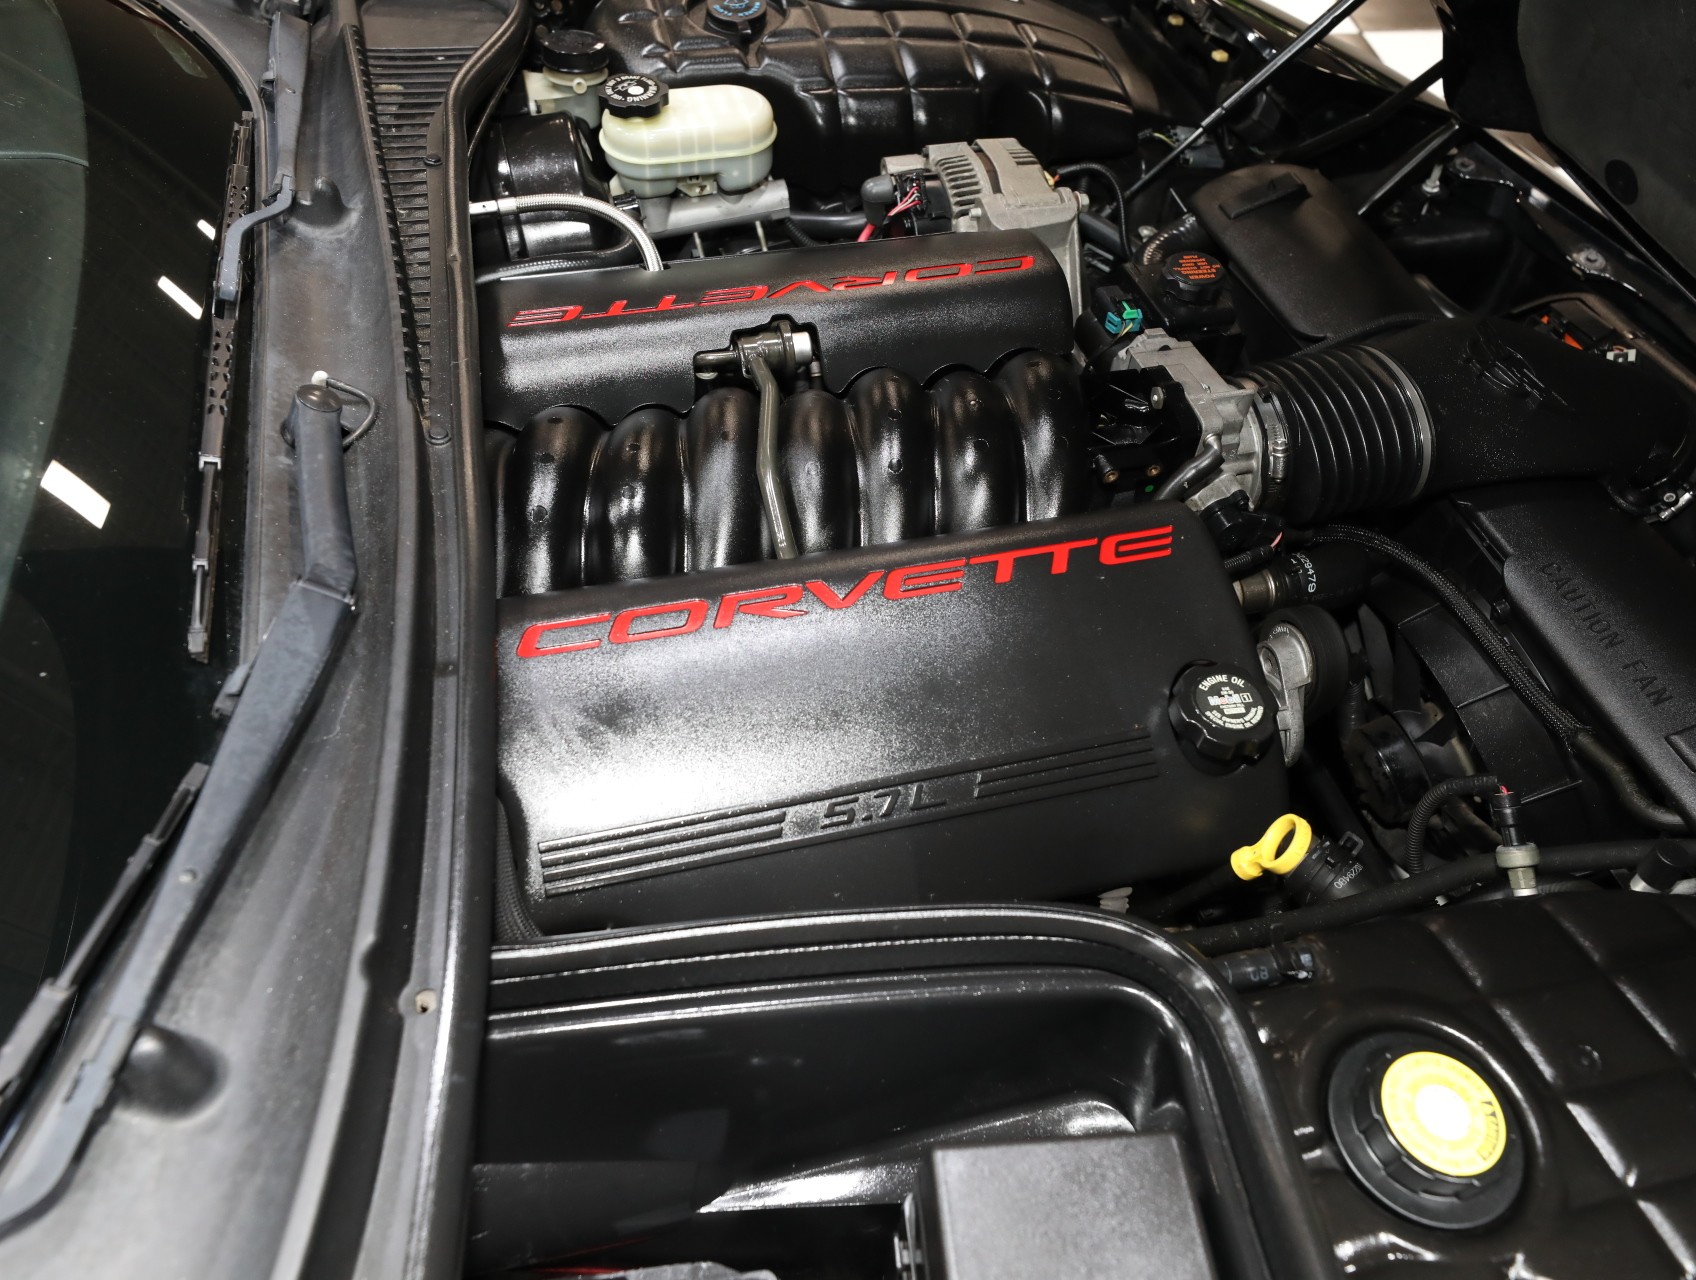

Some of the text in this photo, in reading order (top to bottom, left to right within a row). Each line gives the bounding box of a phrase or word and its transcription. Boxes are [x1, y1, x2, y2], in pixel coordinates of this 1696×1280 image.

[507, 255, 1035, 327] CORVETTE
[516, 524, 1173, 658] CORVETTE
[1540, 562, 1625, 650] CAUTION
[1621, 659, 1674, 707] FAN
[1198, 674, 1245, 691] ENGINE OIL
[1207, 693, 1242, 706] Mobil
[819, 784, 947, 830] 5.7L
